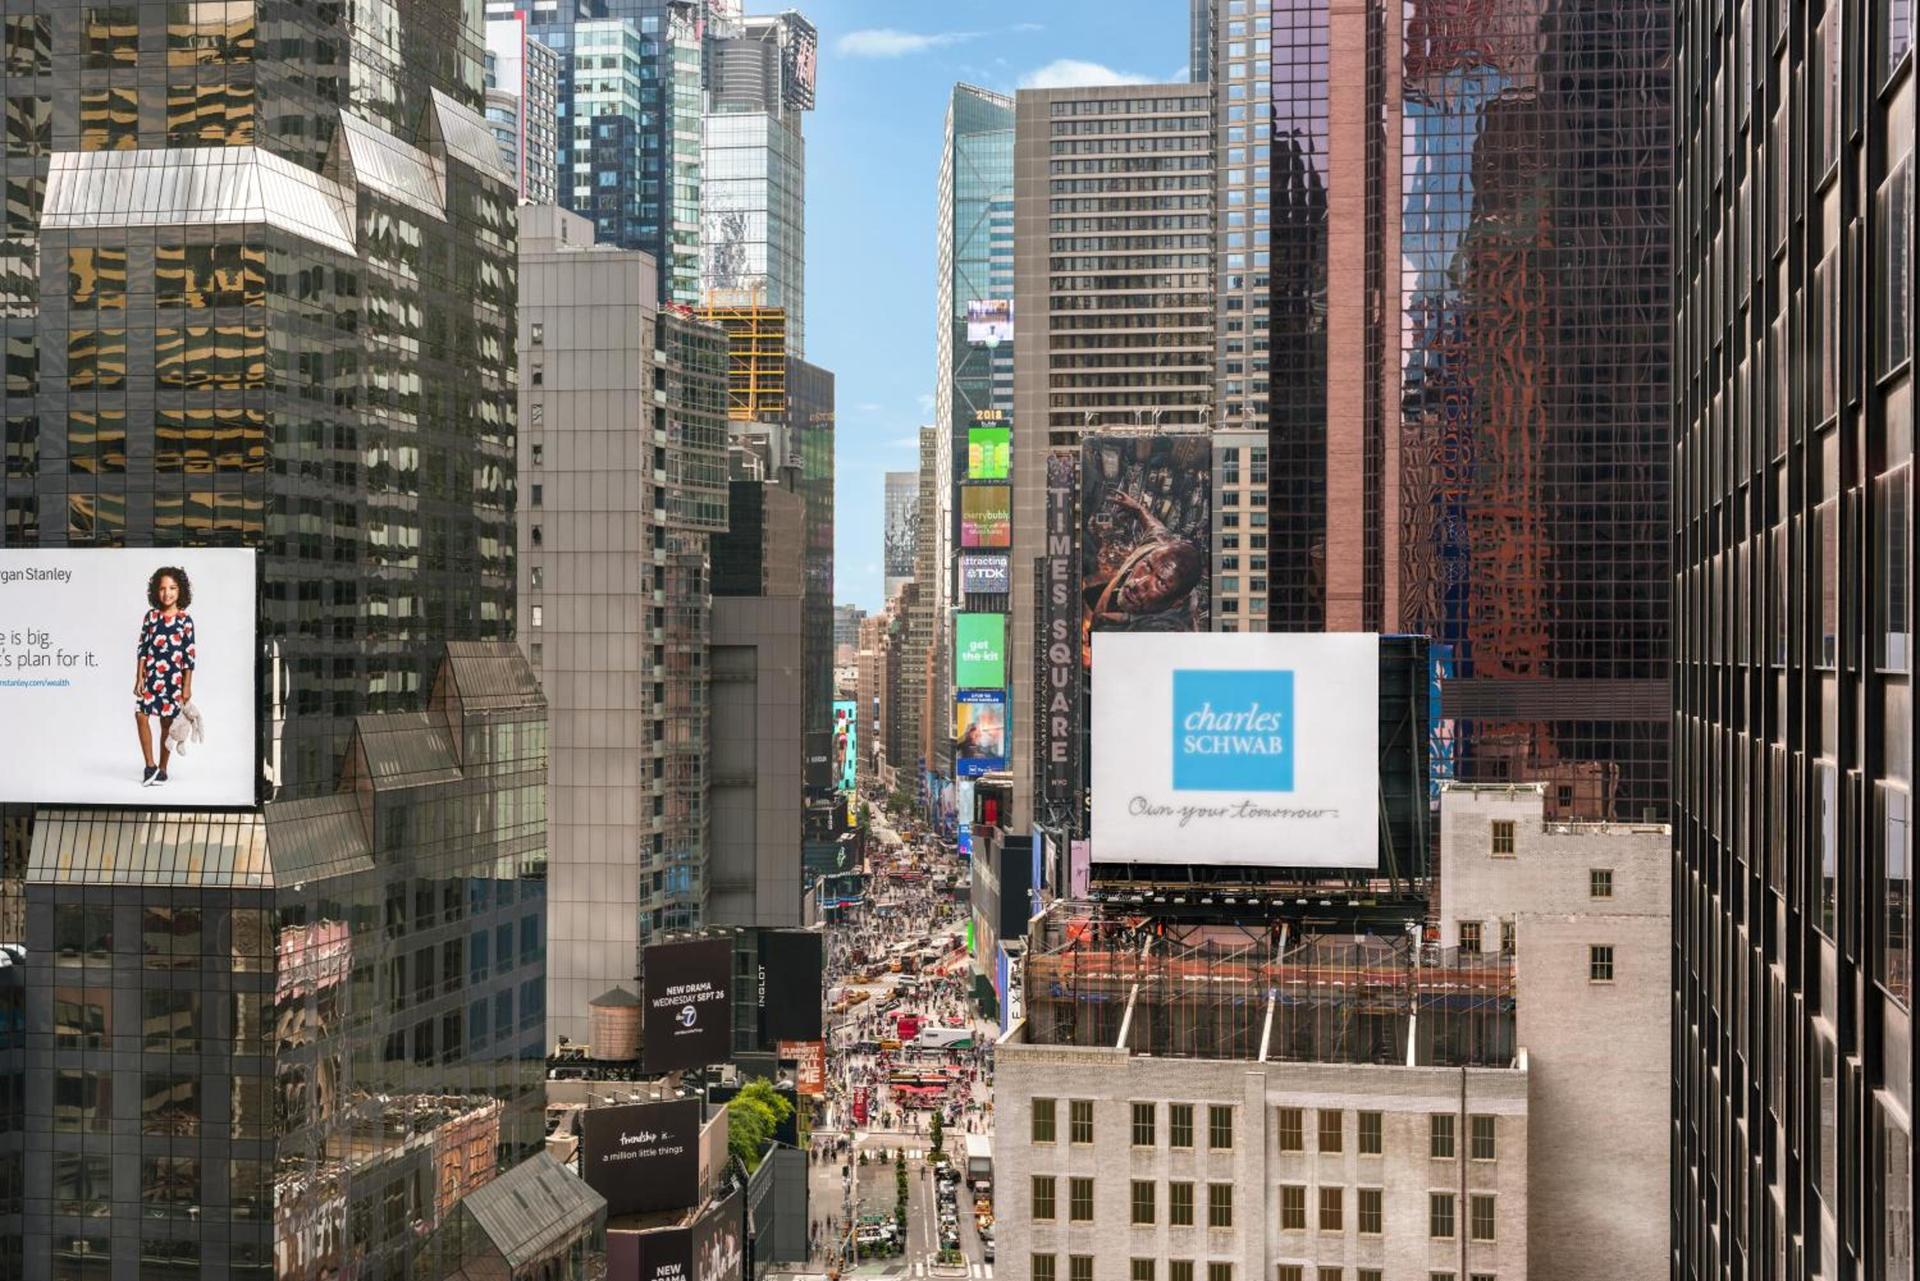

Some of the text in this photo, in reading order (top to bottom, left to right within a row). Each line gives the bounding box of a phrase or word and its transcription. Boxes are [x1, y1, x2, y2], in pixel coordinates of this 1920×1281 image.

[976, 409, 1002, 421] 2018
[0, 567, 72, 584] gan Stanley
[976, 568, 1005, 579] TDK
[1049, 487, 1072, 763] TIMES SQUARE
[11, 630, 22, 646] is
[27, 626, 54, 650] big.
[969, 640, 989, 652] get
[17, 648, 51, 671] plan
[56, 648, 80, 667] for
[85, 651, 99, 667] it.
[983, 650, 999, 662] kit
[1184, 702, 1282, 732] charles
[1184, 735, 1282, 755] SCHWAB
[1127, 796, 1174, 816] Own
[1176, 804, 1229, 828] your
[666, 982, 712, 997] NEW DRAMA
[758, 964, 766, 1007] INGLOT
[652, 990, 725, 1008] WEDNESDAY SEPT 26
[799, 1060, 820, 1070] ALL
[799, 1070, 820, 1083] ME
[619, 1131, 657, 1146] friendship
[602, 1145, 684, 1162] a million little things
[656, 1263, 682, 1277] NEW
